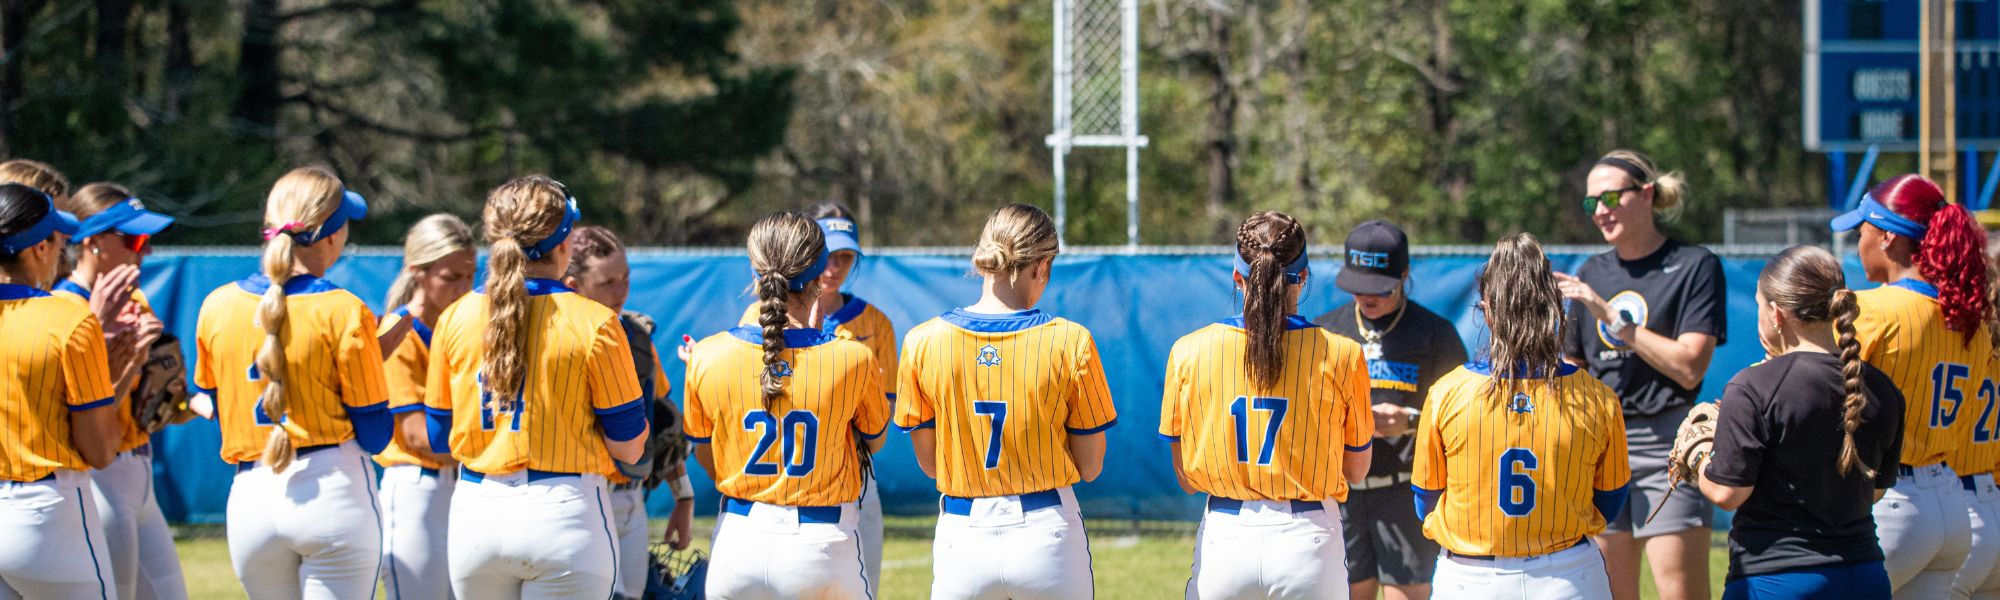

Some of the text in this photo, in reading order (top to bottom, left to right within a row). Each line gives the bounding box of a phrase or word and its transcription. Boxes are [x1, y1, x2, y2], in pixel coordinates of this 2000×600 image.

[1350, 249, 1389, 268] TGC
[1929, 361, 1970, 428] 15
[743, 409, 819, 478] 20
[973, 400, 1008, 470] 7
[1229, 395, 1289, 466] 17
[1498, 448, 1538, 517] 6
